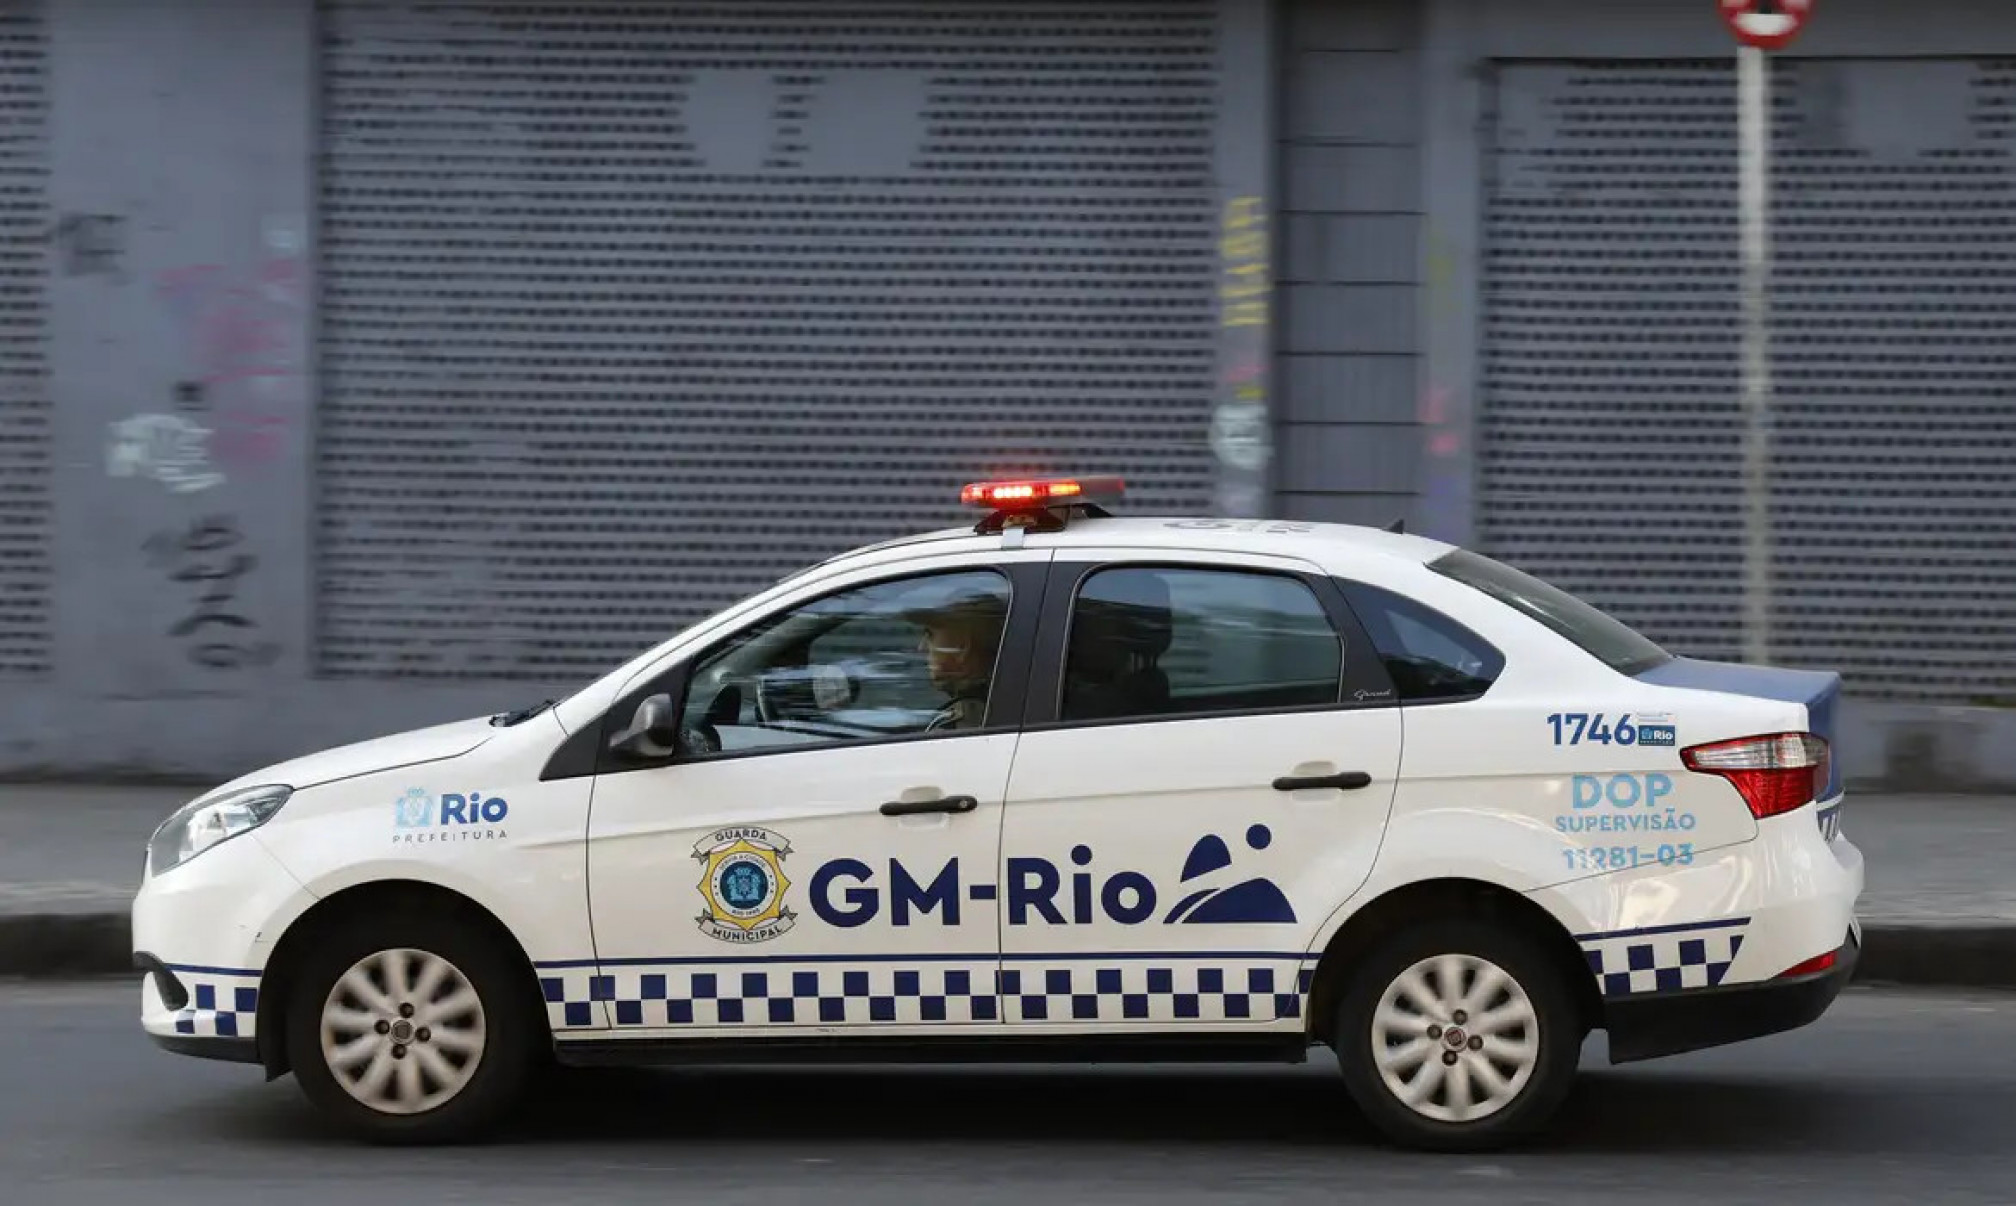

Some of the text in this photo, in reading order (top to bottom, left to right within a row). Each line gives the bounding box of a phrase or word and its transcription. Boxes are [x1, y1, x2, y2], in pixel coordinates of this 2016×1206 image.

[1547, 713, 1636, 745] 1746
[1654, 729, 1673, 740] Rio
[1572, 773, 1672, 809] DOP
[441, 792, 508, 825] Rio
[1556, 808, 1696, 832] SUPERVISÃO
[392, 830, 507, 843] PREFEITURA
[715, 829, 768, 841] GUARDA
[809, 844, 1157, 927] GM-Rio
[713, 926, 783, 941] MUNICIPAL
